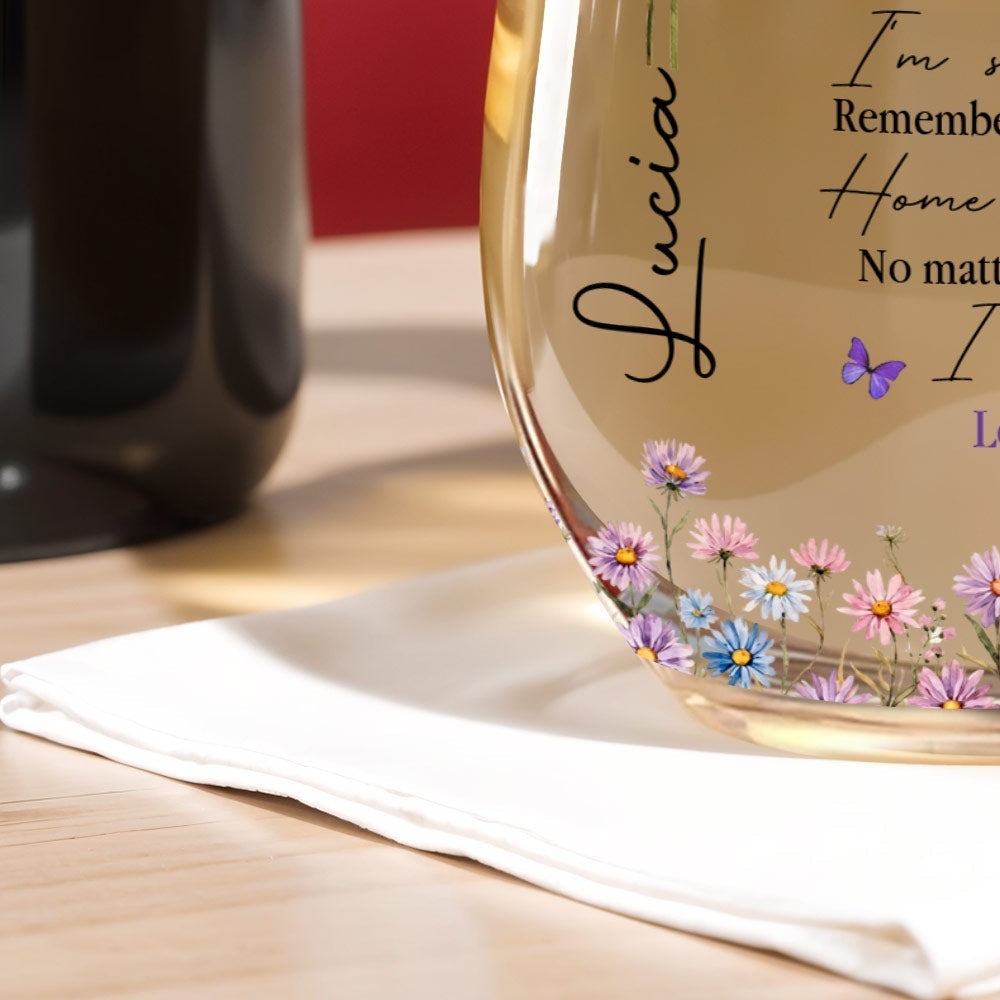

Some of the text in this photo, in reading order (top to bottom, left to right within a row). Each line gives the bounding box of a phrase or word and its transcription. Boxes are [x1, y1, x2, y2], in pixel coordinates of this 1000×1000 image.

[830, 9, 950, 88] I'm
[572, 66, 717, 384] Lucia
[819, 152, 996, 237] Home
[858, 248, 912, 284] No
